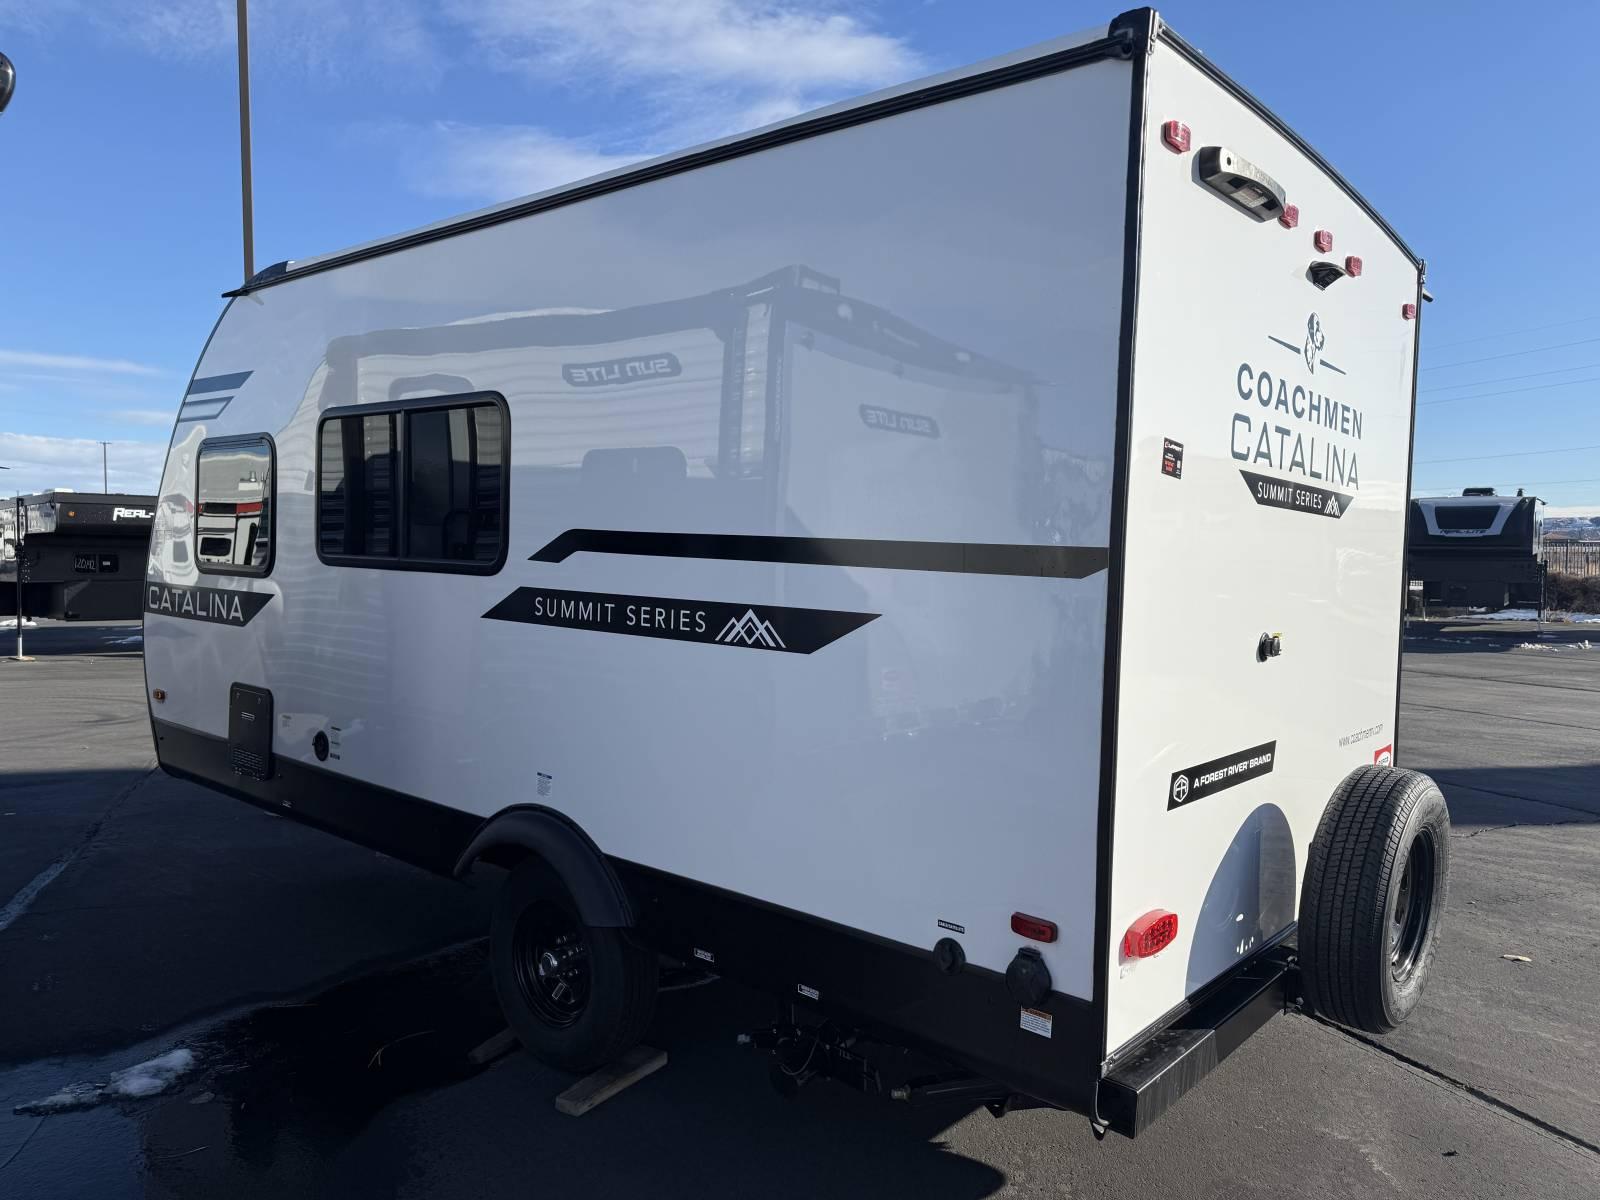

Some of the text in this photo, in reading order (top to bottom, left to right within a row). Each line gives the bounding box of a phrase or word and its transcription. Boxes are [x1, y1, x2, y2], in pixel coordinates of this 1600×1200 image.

[1237, 363, 1362, 440] COACHMEN
[1231, 413, 1359, 490] CATALINA
[1257, 481, 1322, 509] SUMMIT SERIES
[148, 586, 244, 622] CATALINA
[534, 597, 707, 633] SUMMIT SERIES
[1193, 778, 1200, 789] A
[1200, 767, 1228, 786] FOREST
[1249, 753, 1272, 769] BRAND
